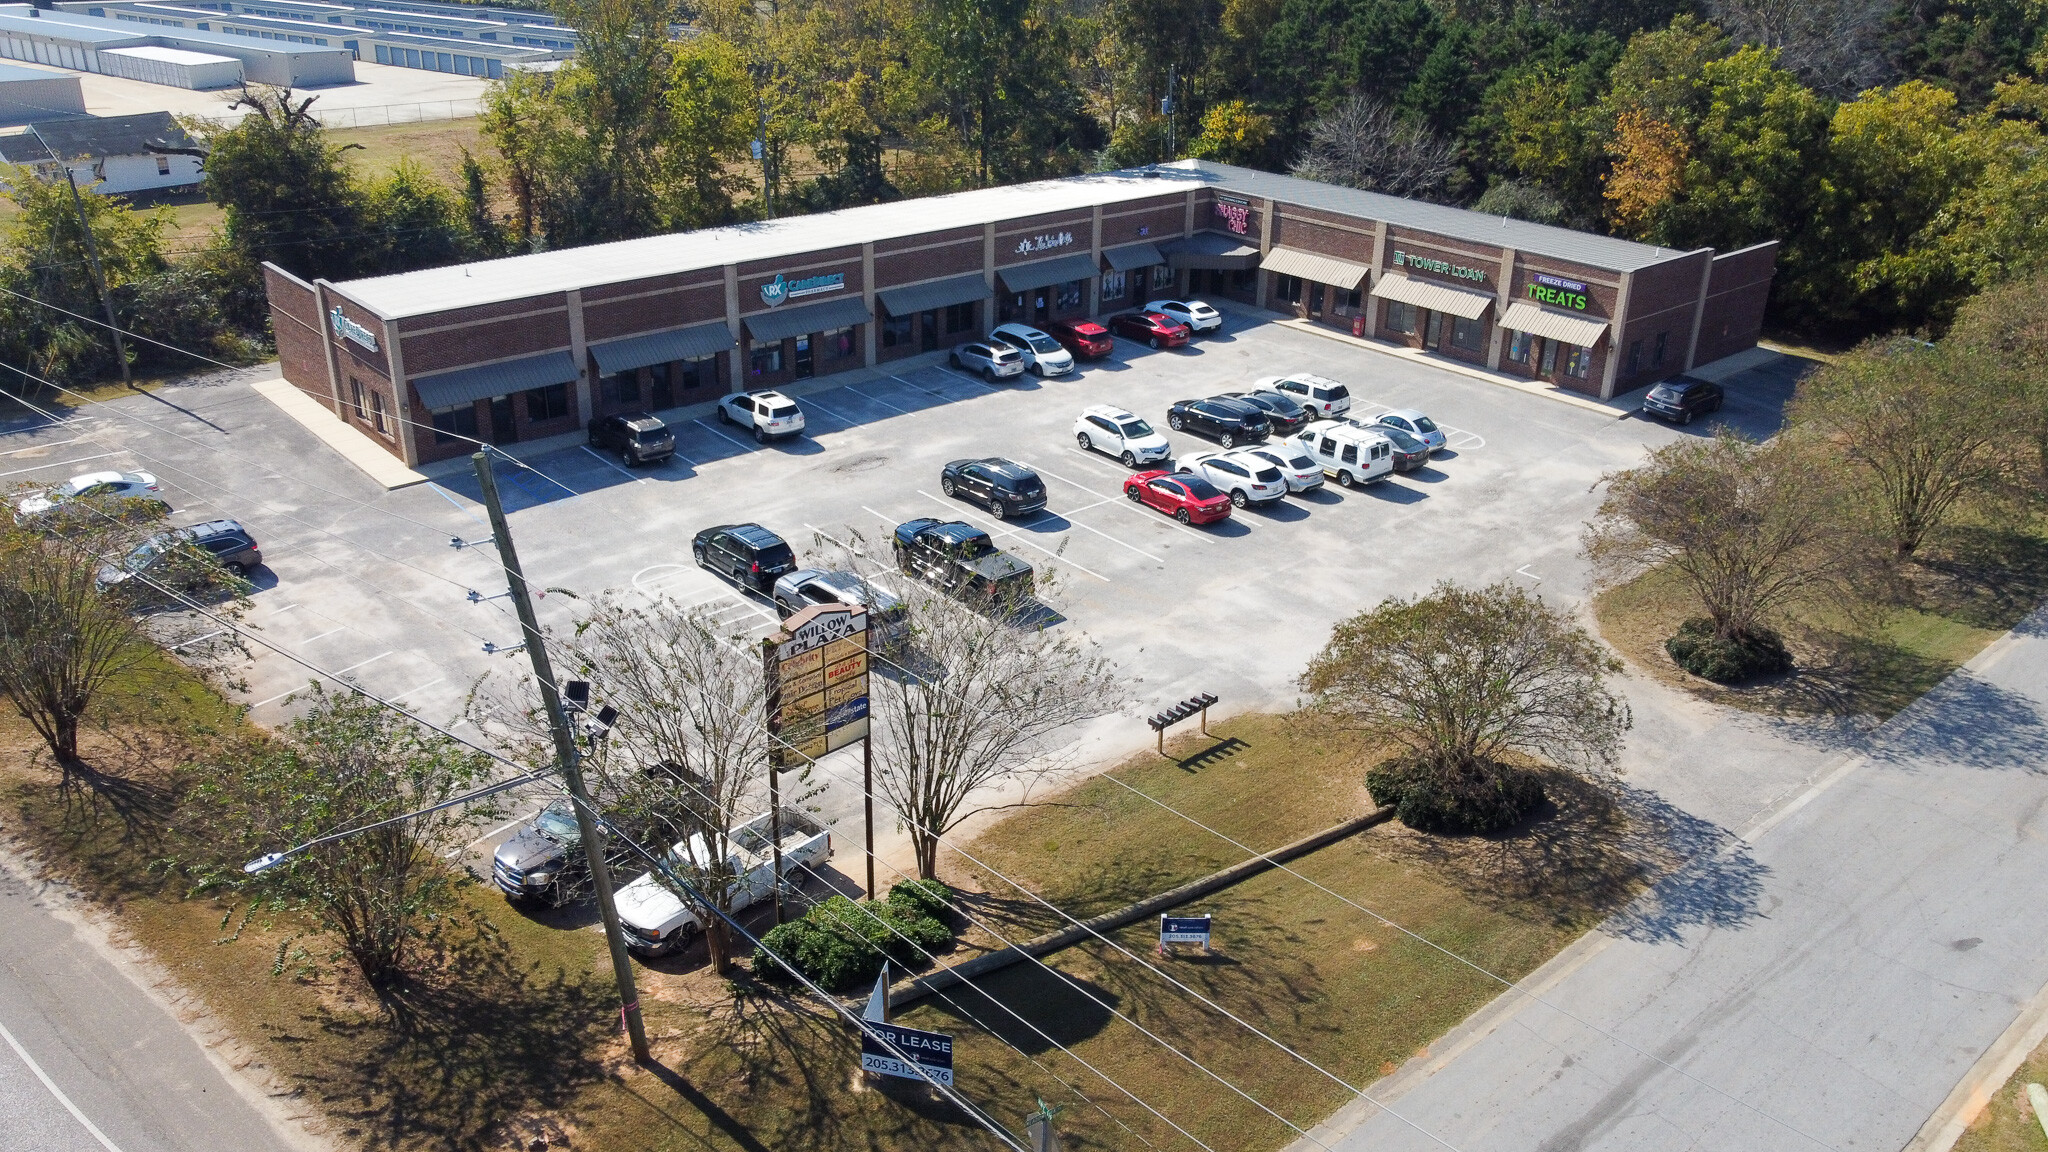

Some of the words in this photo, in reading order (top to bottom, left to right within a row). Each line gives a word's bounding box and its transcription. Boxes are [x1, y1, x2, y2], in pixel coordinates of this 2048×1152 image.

[1405, 254, 1449, 274] TOWER
[1451, 264, 1484, 282] LOAN
[1527, 283, 1587, 310] TREATS
[1538, 275, 1562, 287] FREEZE
[1562, 281, 1582, 291] DRIED
[789, 623, 857, 656] PLAZA
[798, 614, 848, 641] WILLOW
[828, 660, 862, 679] BEAUTY
[901, 1035, 951, 1053] LEASE
